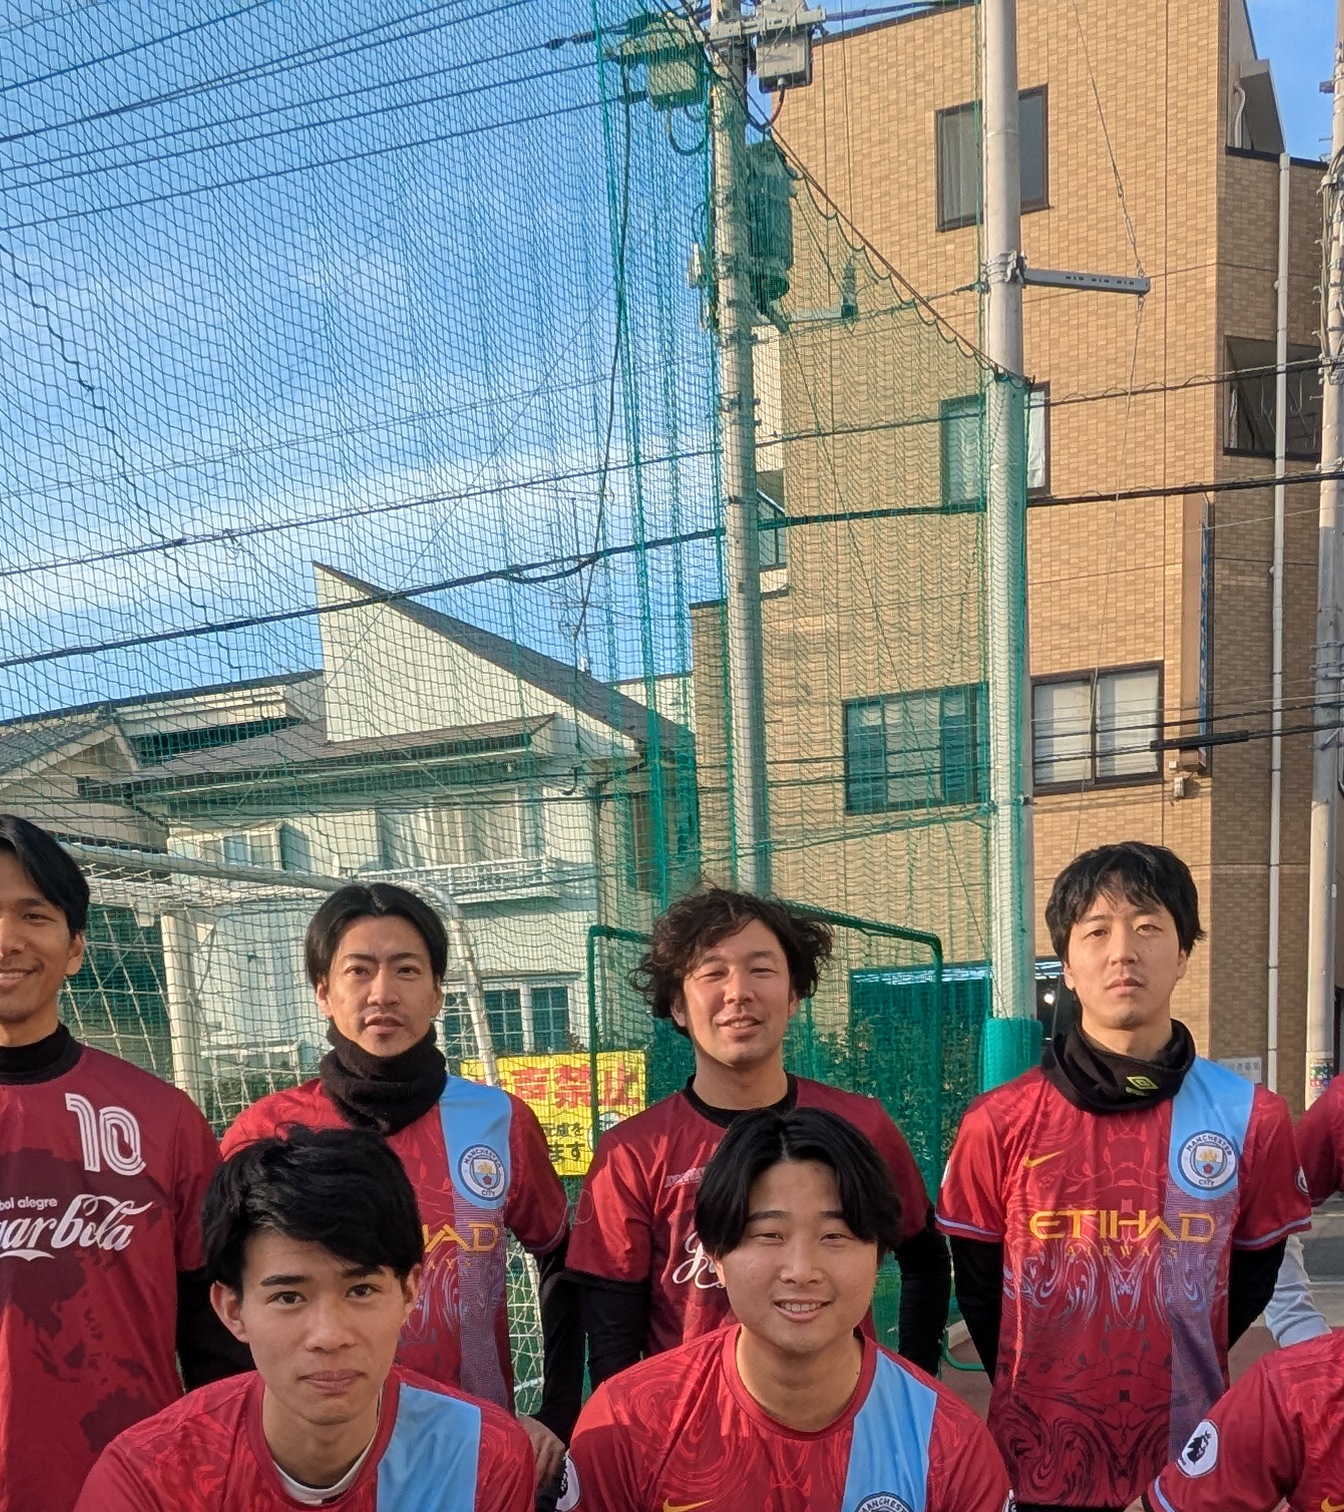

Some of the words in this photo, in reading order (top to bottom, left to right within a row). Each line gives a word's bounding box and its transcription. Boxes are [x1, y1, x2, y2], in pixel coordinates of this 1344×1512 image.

[473, 1060, 640, 1109] 声禁止
[64, 1092, 146, 1176] 10
[1185, 1134, 1233, 1156] MANCHESTER
[1197, 1178, 1215, 1187] CITY
[16, 1195, 58, 1212] alegre
[1028, 1209, 1217, 1244] ETIHAD
